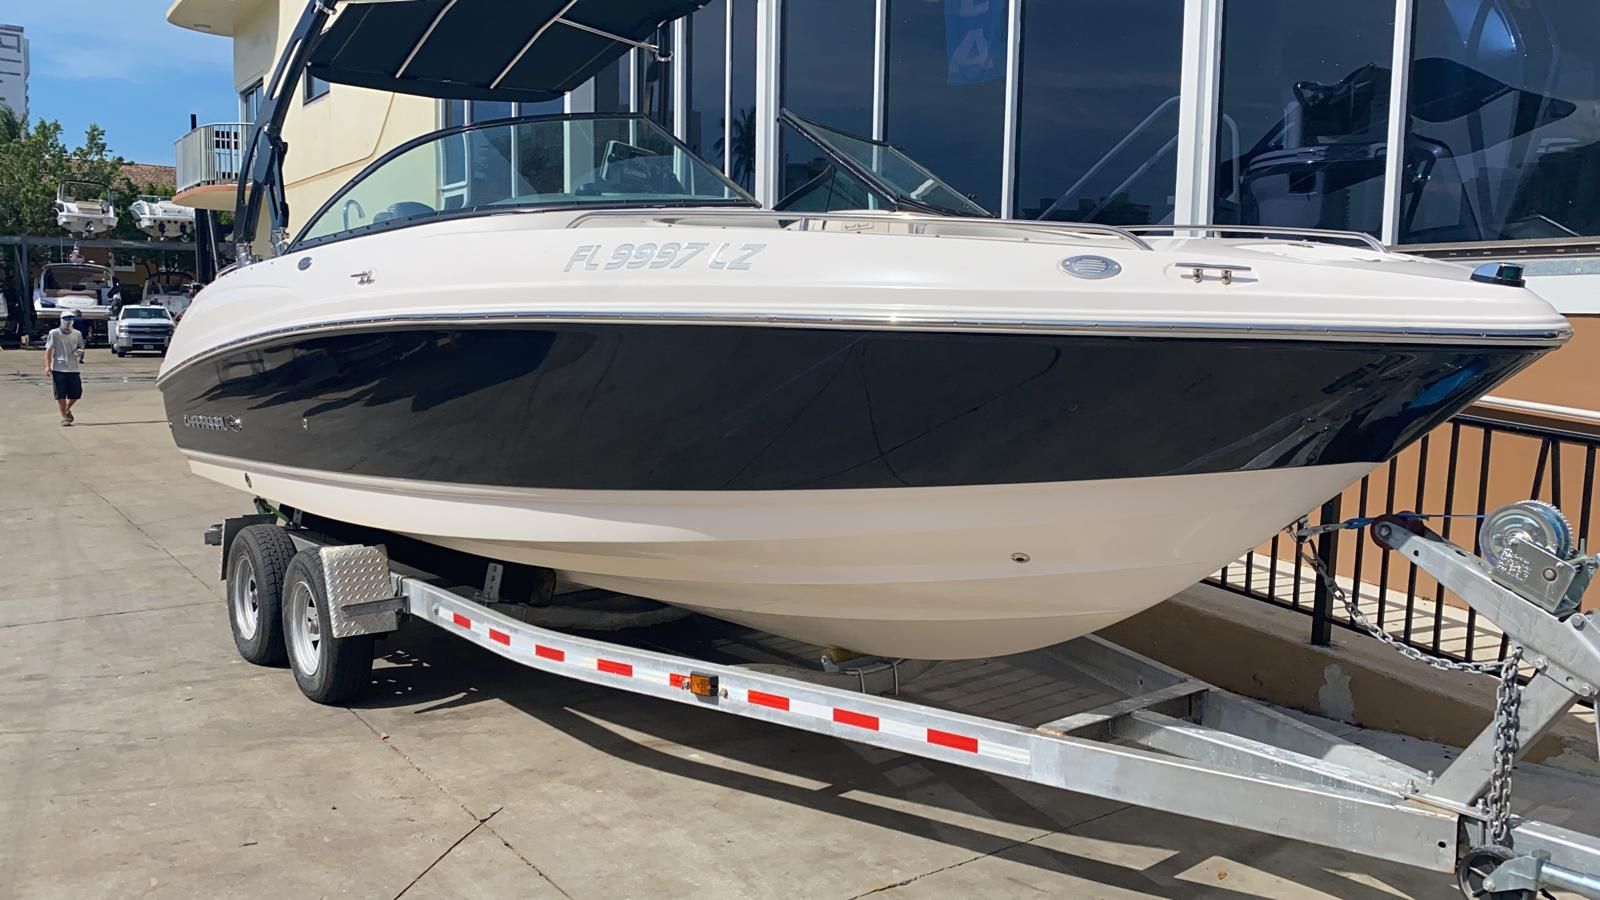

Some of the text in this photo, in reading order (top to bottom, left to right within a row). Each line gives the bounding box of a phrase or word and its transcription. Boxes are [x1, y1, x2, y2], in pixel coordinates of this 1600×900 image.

[563, 242, 767, 272] FL 9997 LZ
